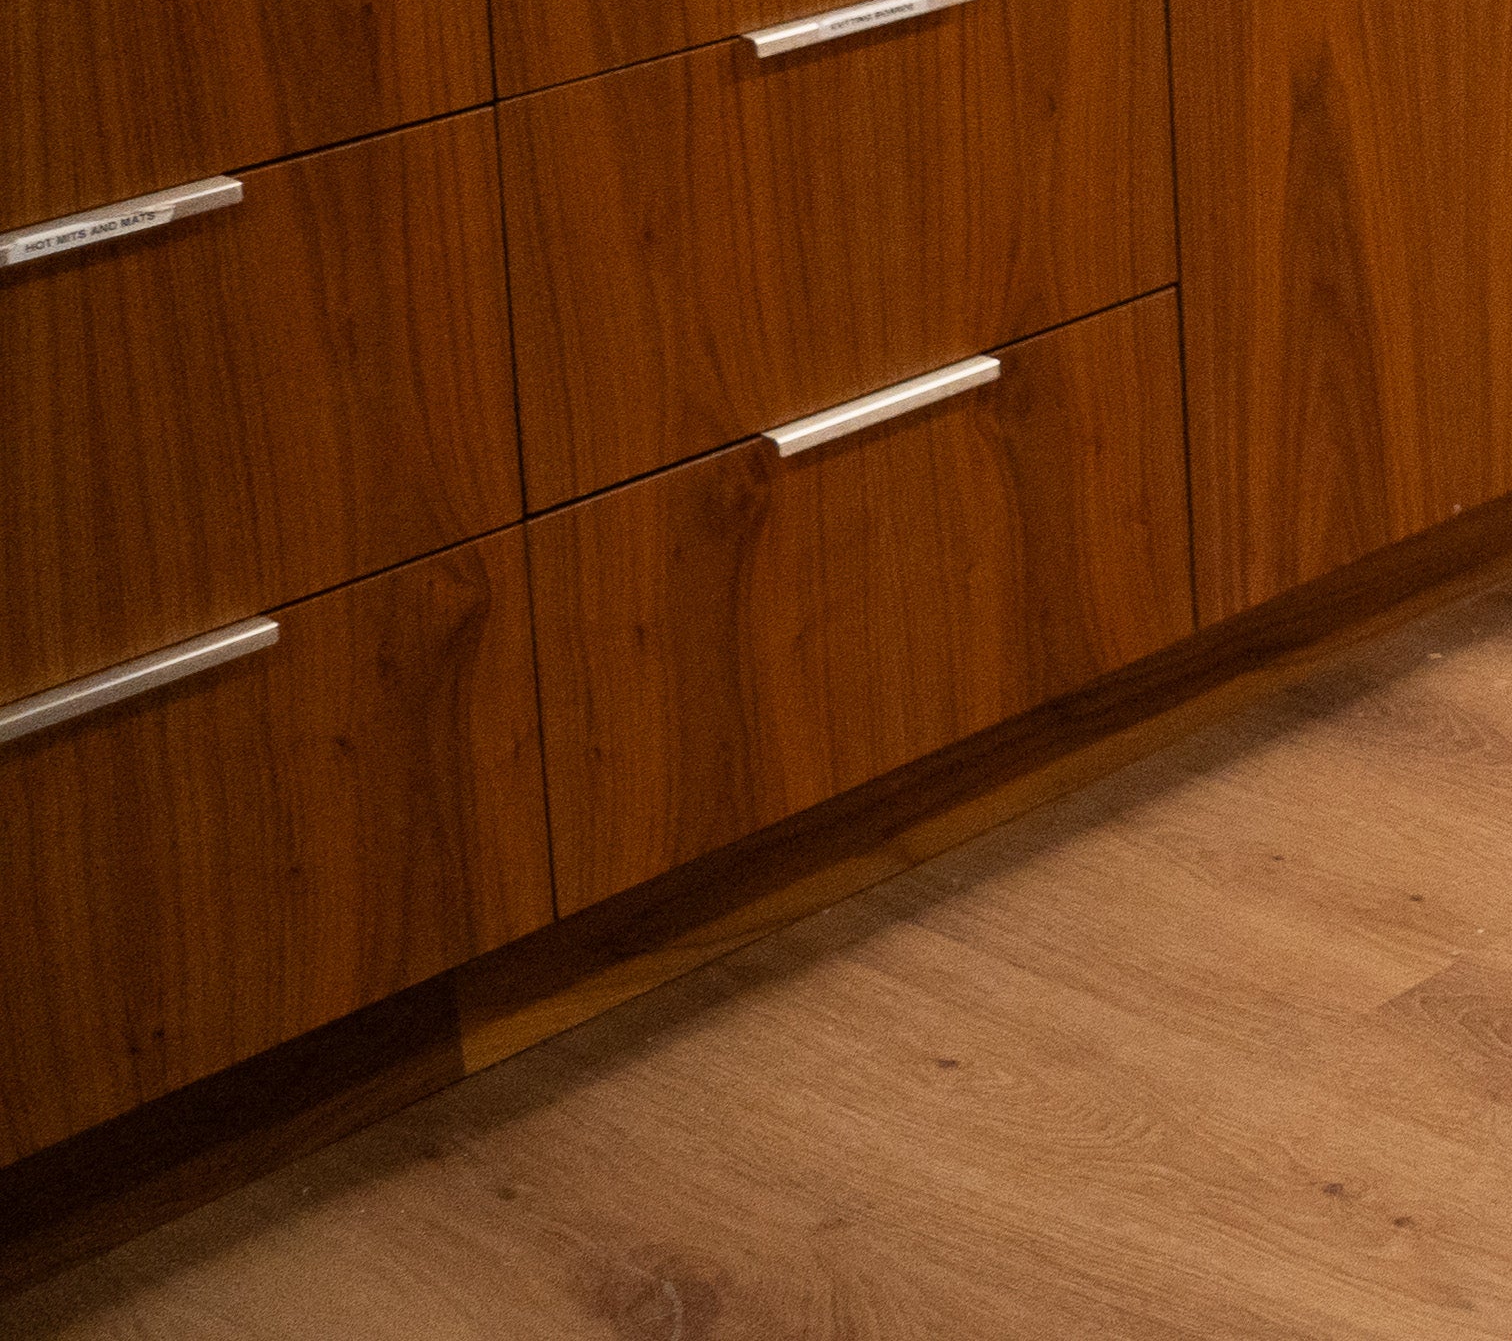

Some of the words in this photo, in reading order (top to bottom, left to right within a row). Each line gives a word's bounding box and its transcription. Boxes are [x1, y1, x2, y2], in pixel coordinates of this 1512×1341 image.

[25, 239, 52, 253] HOT
[90, 220, 117, 235] AND
[120, 210, 156, 228] MATS
